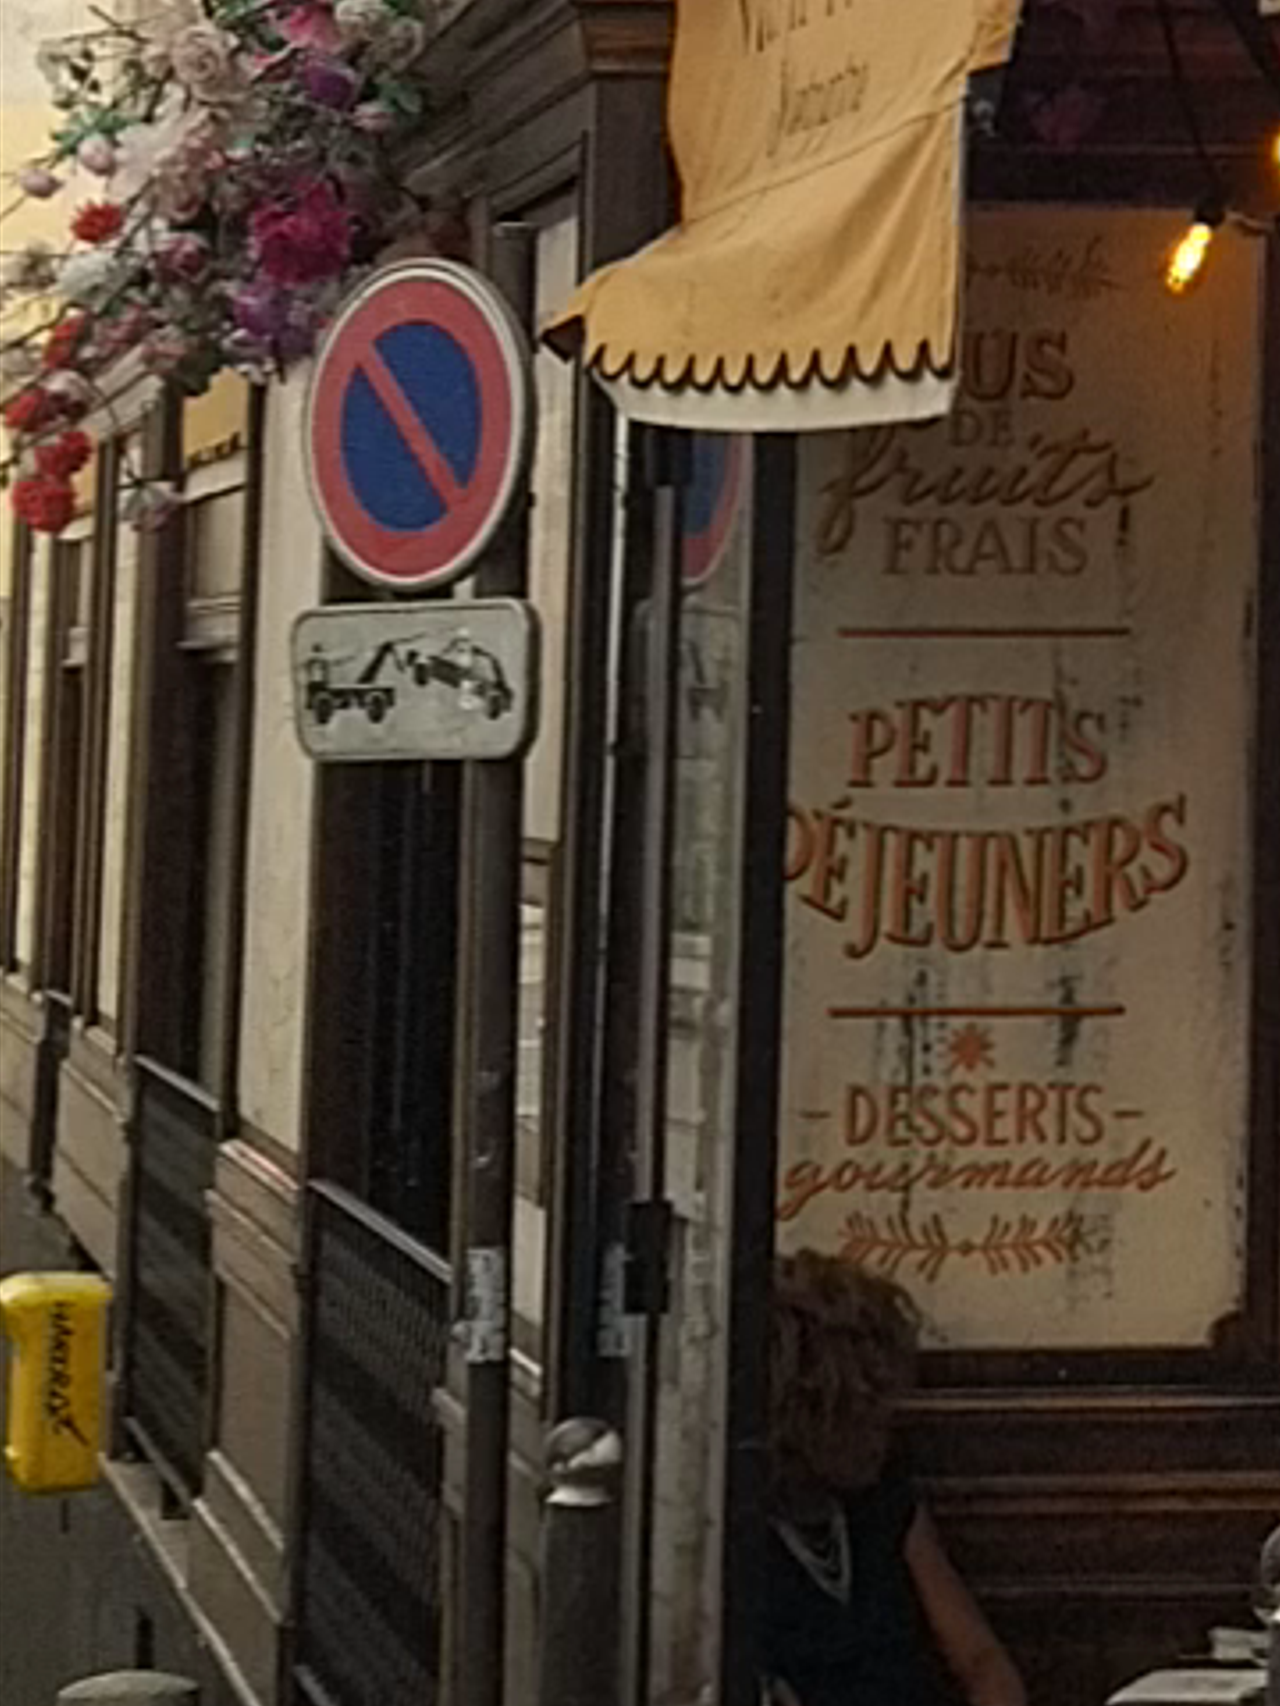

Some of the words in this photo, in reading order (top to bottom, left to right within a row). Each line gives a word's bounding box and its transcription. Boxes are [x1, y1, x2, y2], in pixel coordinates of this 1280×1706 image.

[964, 328, 1077, 404] US
[948, 410, 1015, 448] DE
[881, 516, 1089, 577] FRAIS
[846, 692, 1110, 787] PETITS
[782, 792, 1190, 959] DÉJEUNERS
[845, 1084, 1105, 1147] DESSERTS
[775, 1137, 1177, 1222] gourmands
